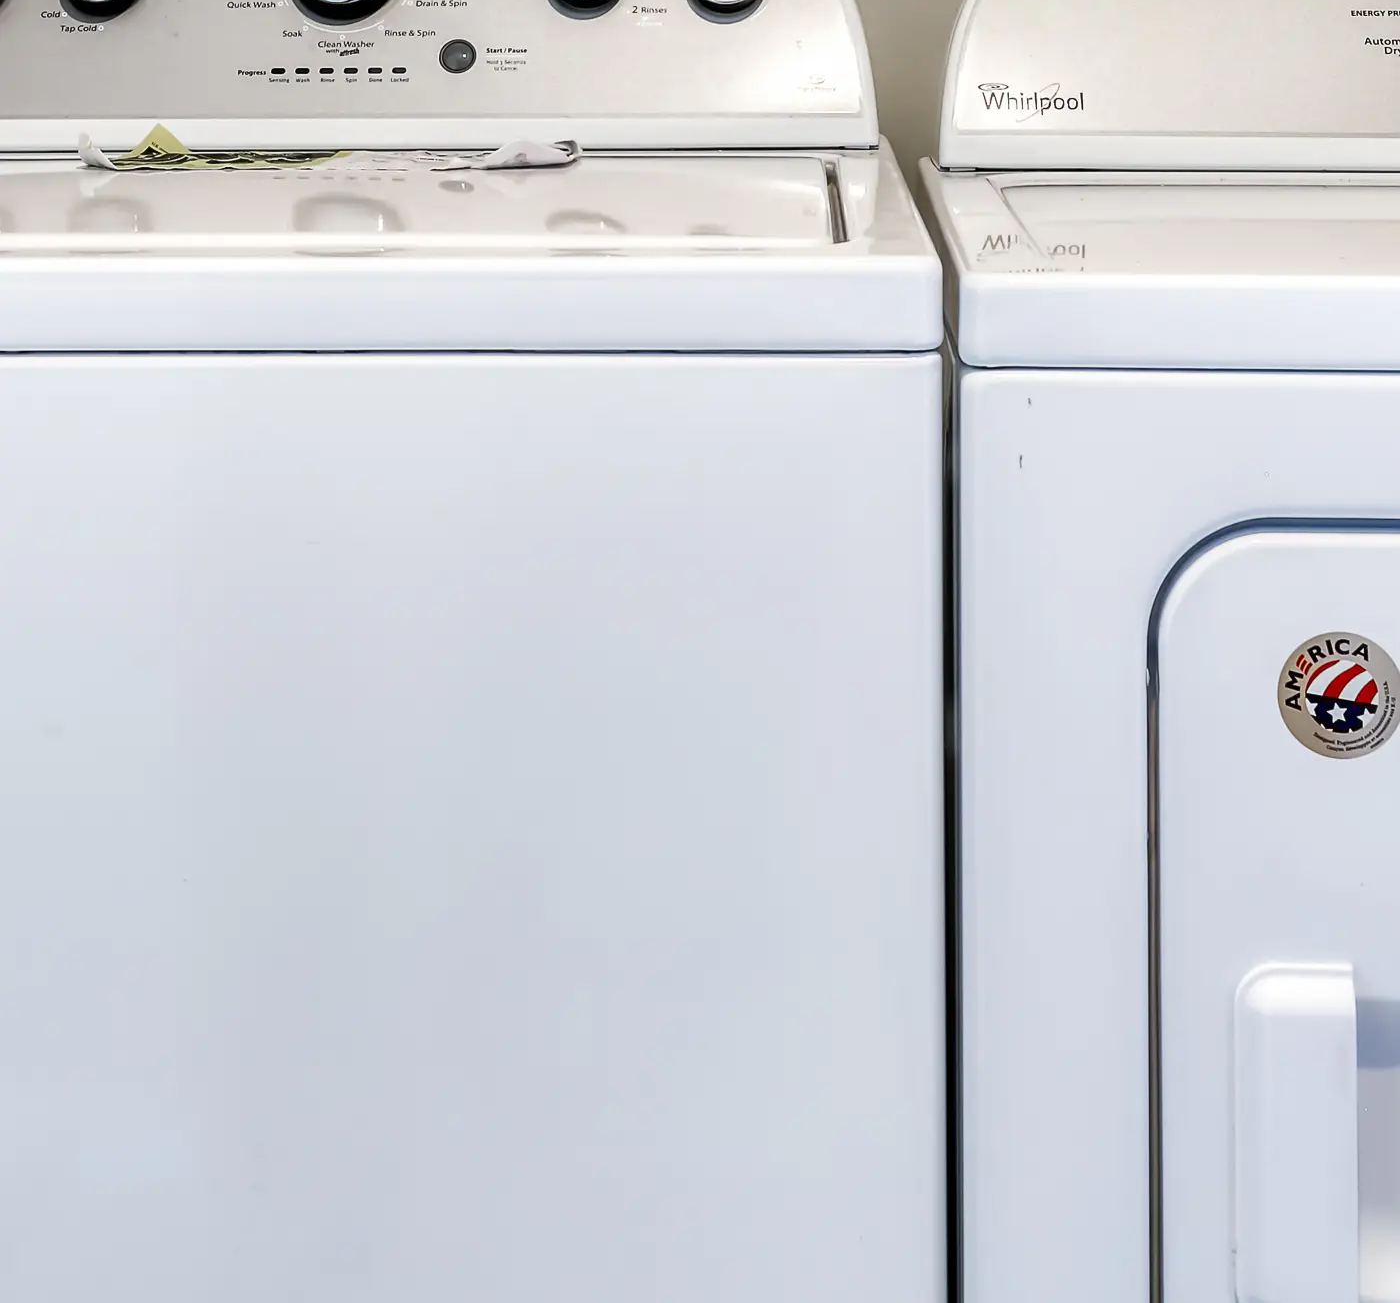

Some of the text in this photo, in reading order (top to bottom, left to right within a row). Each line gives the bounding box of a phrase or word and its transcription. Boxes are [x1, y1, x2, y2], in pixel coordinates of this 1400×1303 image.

[226, 1, 251, 9] Quick
[449, 0, 468, 8] Spin
[632, 6, 638, 14] 2
[61, 24, 98, 33] Tap Cold
[282, 30, 303, 38] Soak
[384, 29, 407, 37] Rinse
[417, 30, 436, 38] Spin
[237, 69, 267, 77] Progress
[982, 91, 1084, 116] Whirlpool
[1285, 639, 1369, 711] AMERICA
